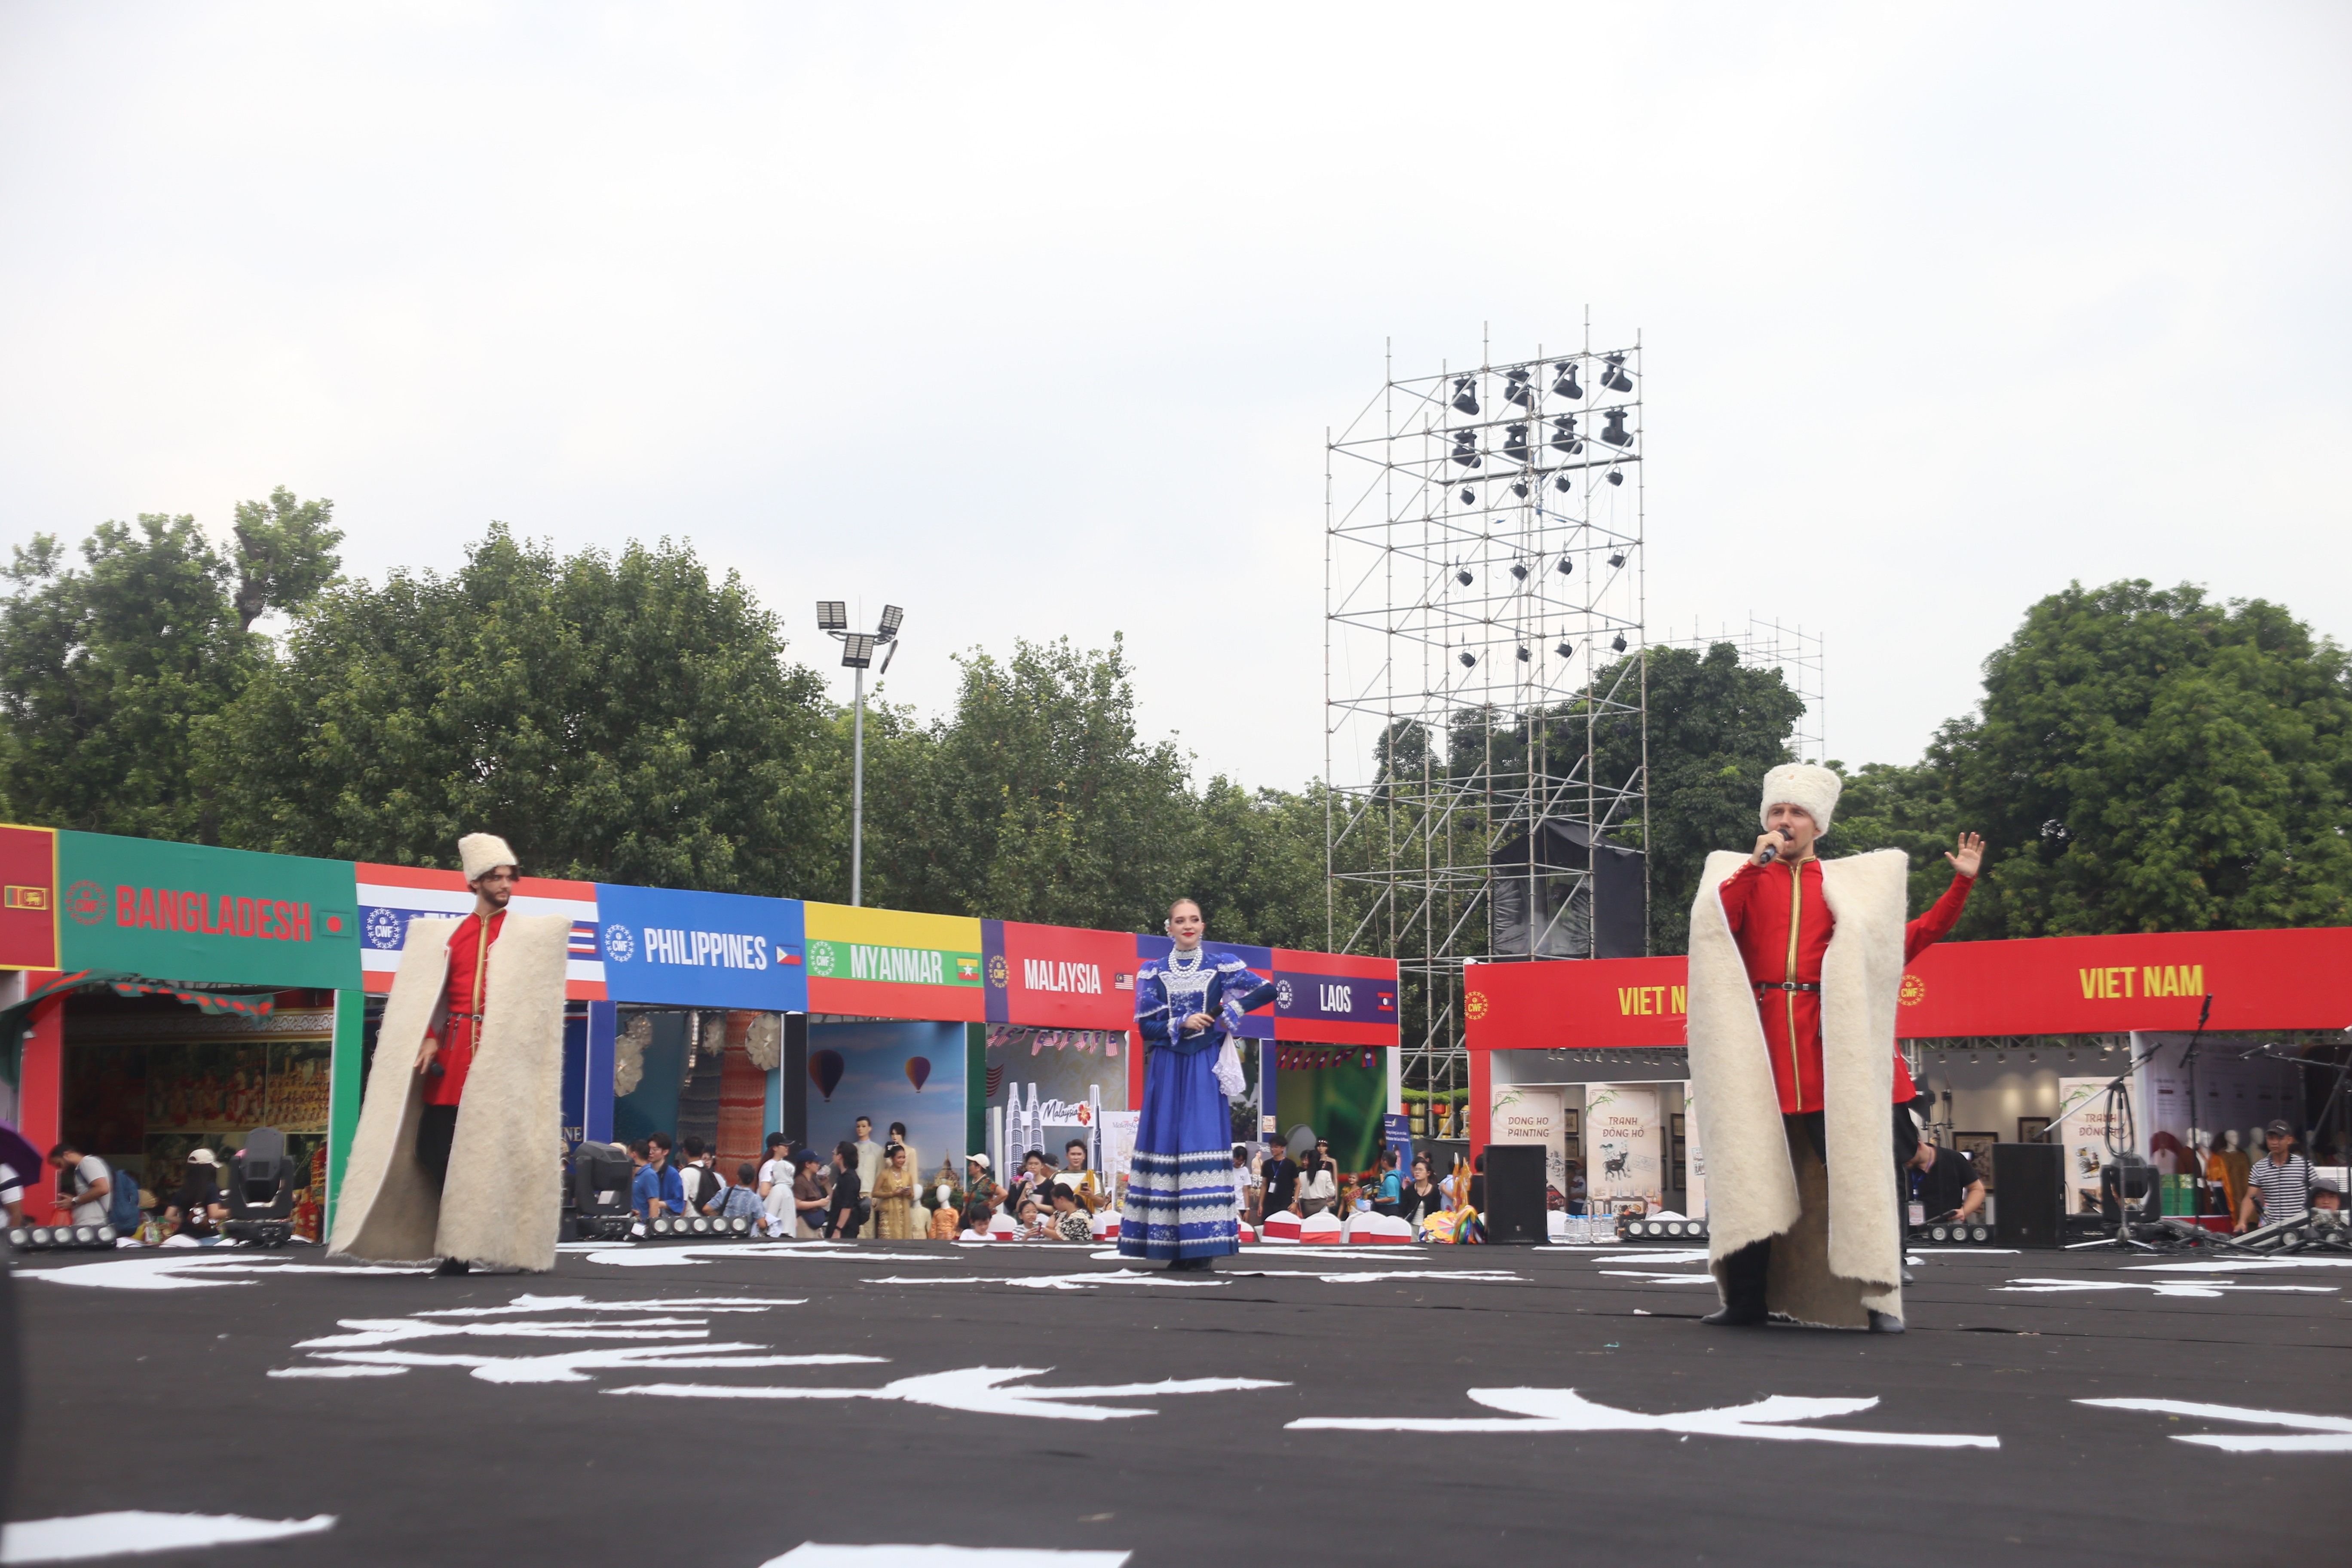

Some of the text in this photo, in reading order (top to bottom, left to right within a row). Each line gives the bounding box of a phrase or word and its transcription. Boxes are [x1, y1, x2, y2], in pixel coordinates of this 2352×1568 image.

[75, 899, 99, 913] CWF
[116, 885, 311, 942] BANGLADESH
[375, 925, 393, 937] CWF
[612, 940, 628, 951] CWF
[643, 928, 767, 970] PHILIPPINES
[816, 956, 830, 966] CWF
[850, 945, 943, 983] MYANMAR
[993, 969, 1005, 979] CWF
[1024, 959, 1101, 994] MALAYSIA
[2078, 965, 2203, 999] VIET NAM
[1280, 992, 1289, 1001] CWF
[1320, 984, 1351, 1013] LAOS
[1901, 988, 1917, 997] CWF
[1617, 986, 1665, 1015] VIET
[1468, 1003, 1482, 1012] CWF
[1043, 1100, 1078, 1123] Malaysia
[1508, 1117, 1549, 1125] DONG HO
[1608, 1117, 1637, 1125] TRANH
[1507, 1129, 1549, 1137] PAINTING
[1631, 1125, 1644, 1137] HỒ
